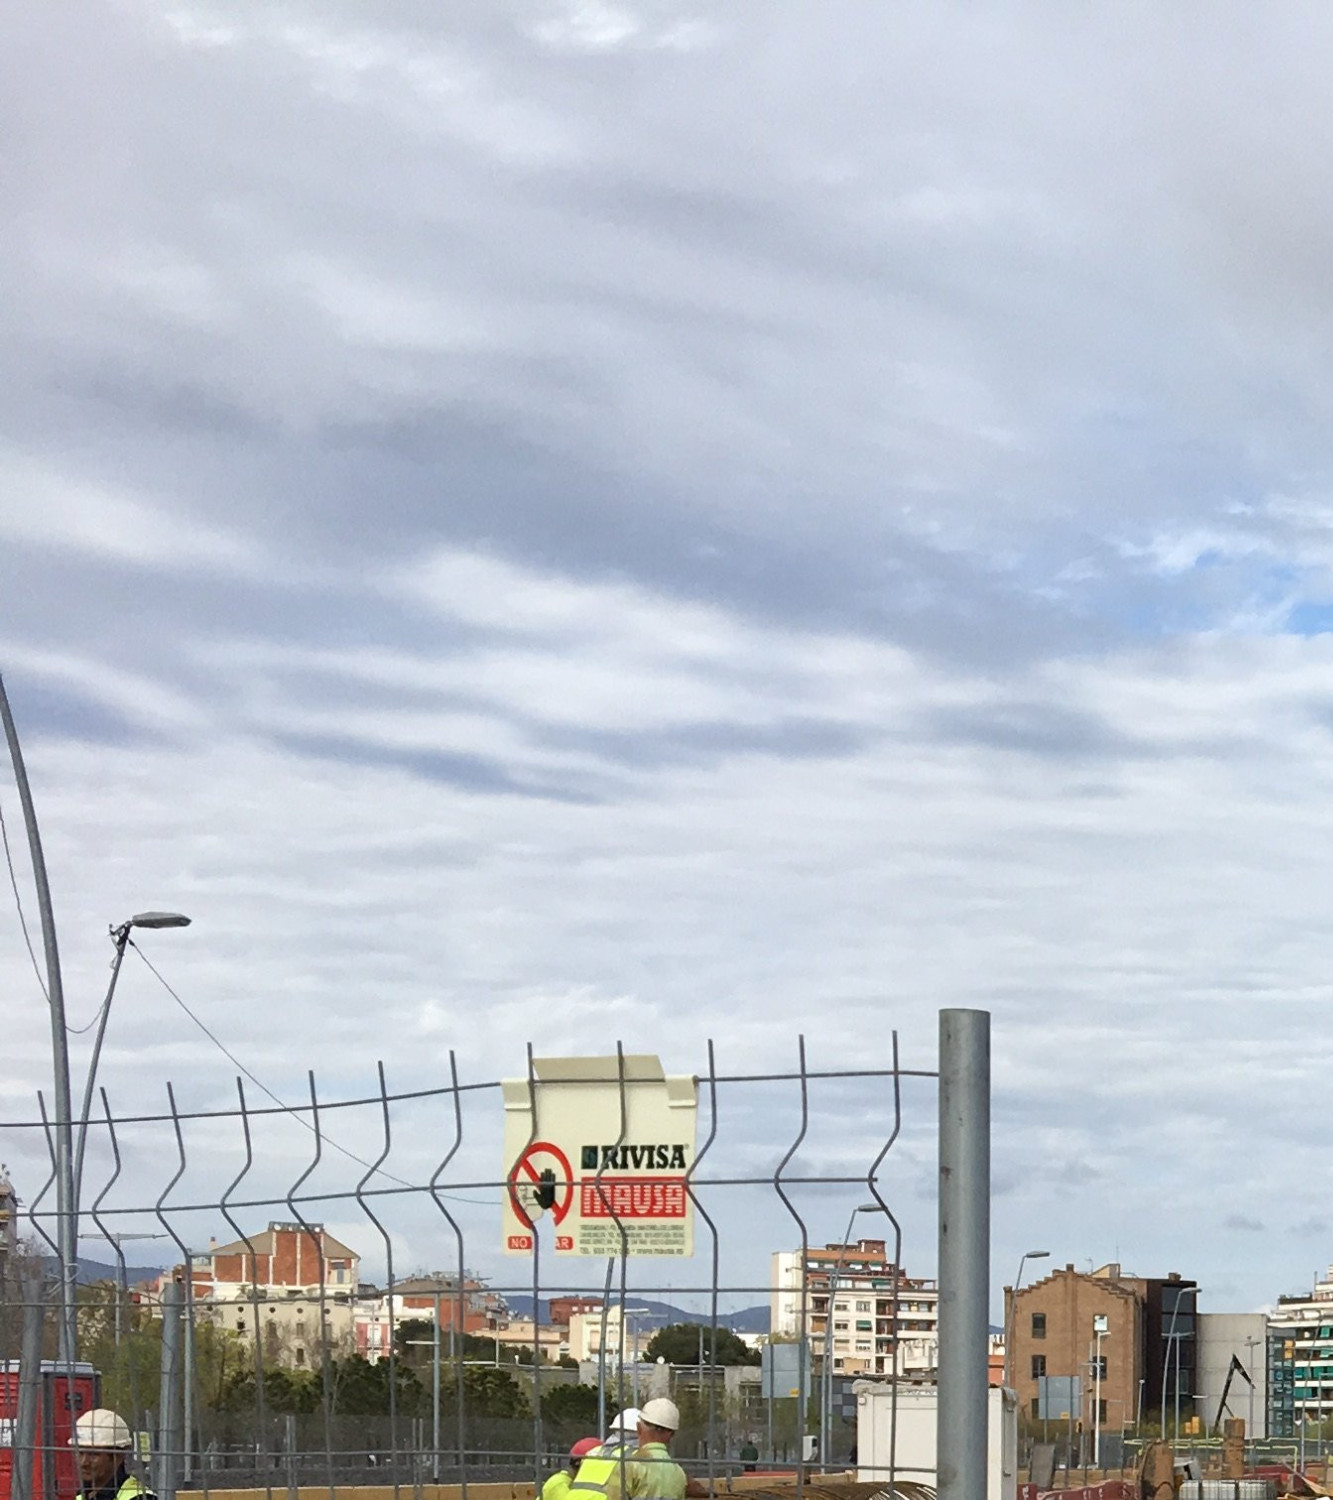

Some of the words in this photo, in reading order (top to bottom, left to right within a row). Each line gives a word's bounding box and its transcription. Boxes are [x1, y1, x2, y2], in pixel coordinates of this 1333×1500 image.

[601, 1144, 686, 1169] RIVISA
[582, 1182, 684, 1214] MAUSA
[510, 1237, 528, 1248] NO
